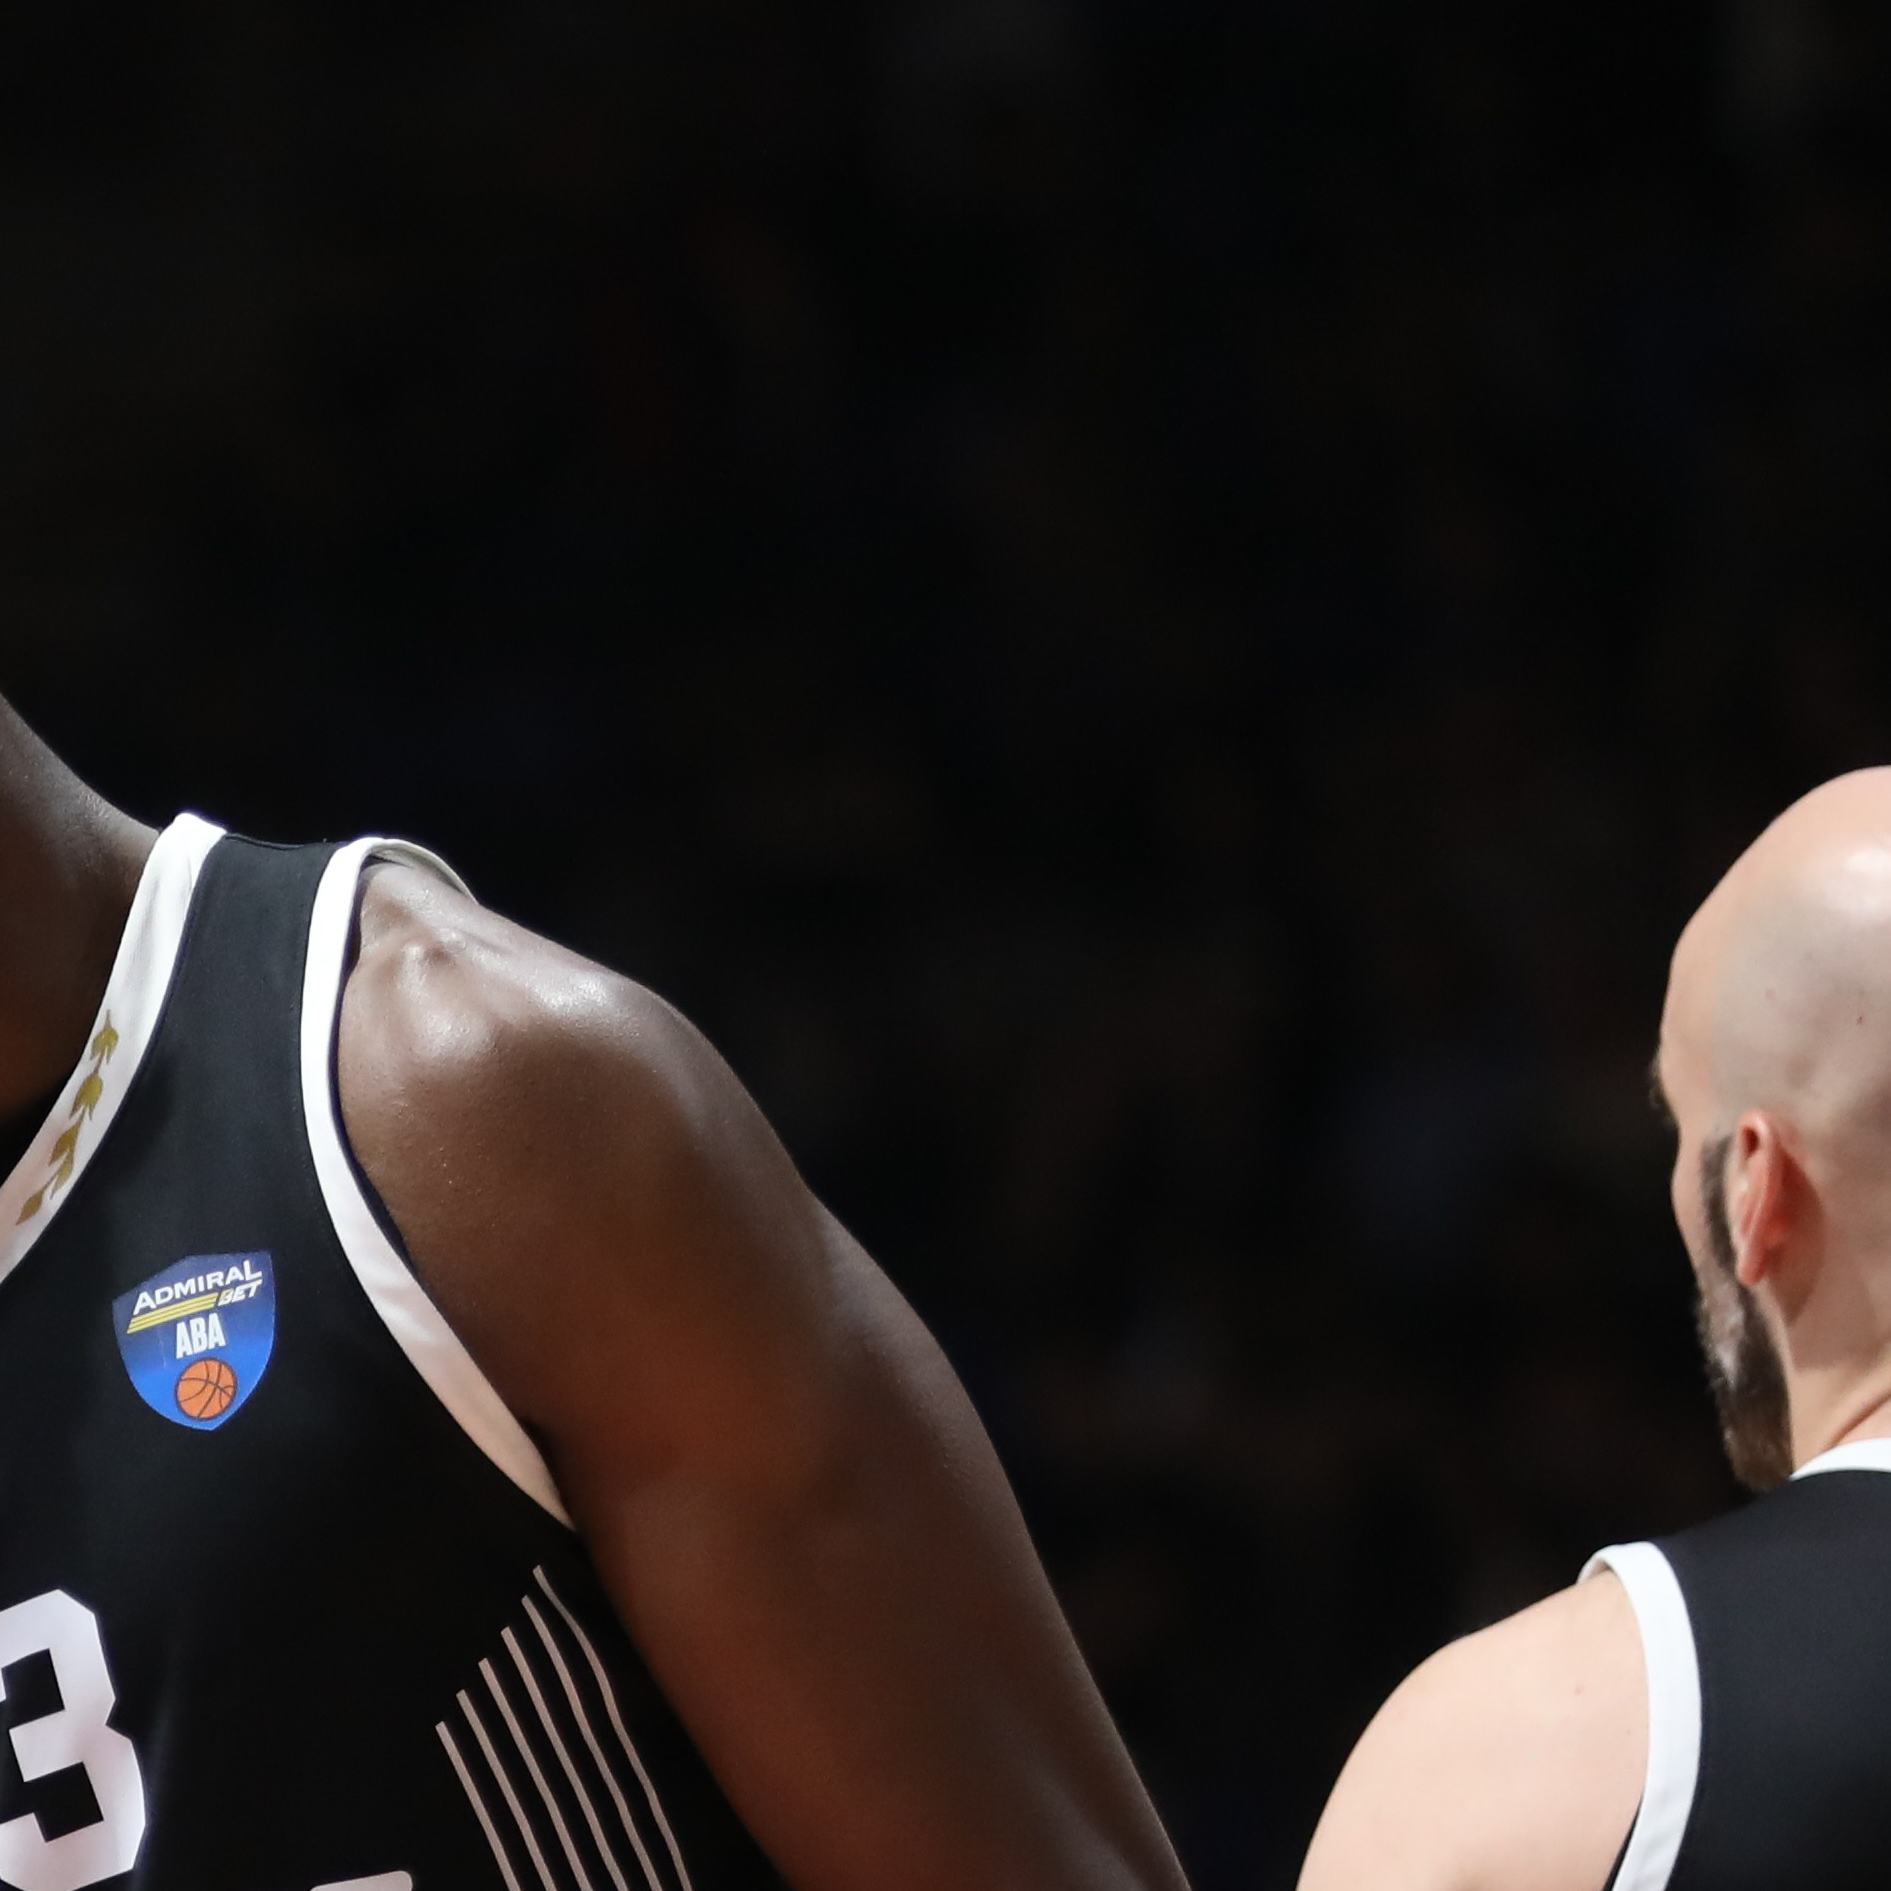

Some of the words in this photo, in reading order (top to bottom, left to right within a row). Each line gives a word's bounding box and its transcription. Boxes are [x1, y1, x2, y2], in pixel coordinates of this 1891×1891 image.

[133, 1260, 263, 1315] ADMIRAL
[218, 1279, 263, 1306] BET
[176, 1313, 226, 1359] ABA
